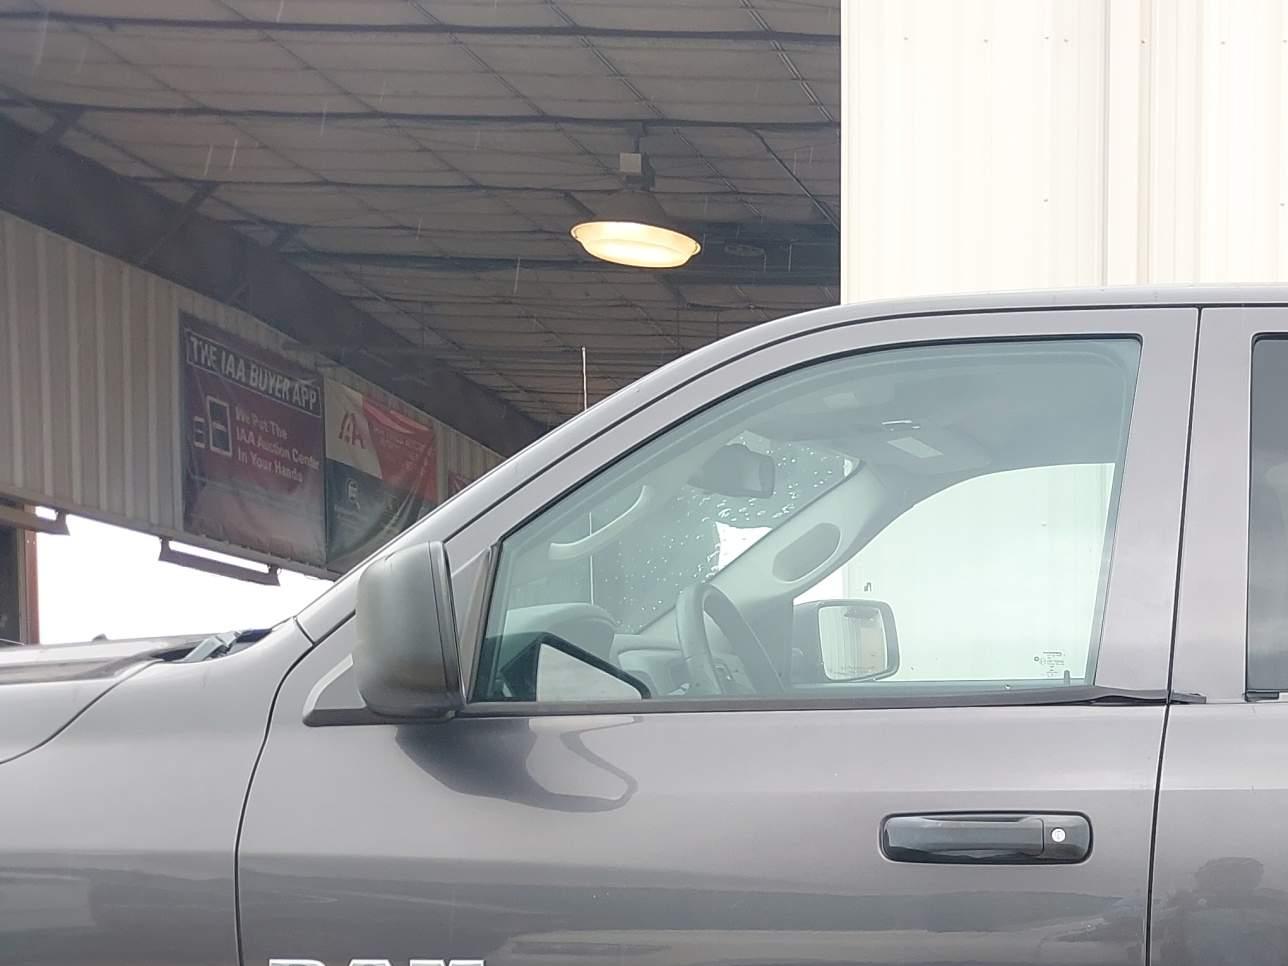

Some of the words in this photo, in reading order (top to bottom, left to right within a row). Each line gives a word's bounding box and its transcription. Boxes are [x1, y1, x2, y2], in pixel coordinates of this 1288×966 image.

[190, 336, 217, 371] THE
[221, 350, 246, 383] IAA
[249, 362, 290, 401] BUYER
[292, 383, 317, 410] APP
[236, 426, 256, 446] IAA
[257, 435, 290, 461] Auction
[270, 421, 288, 440] The
[238, 448, 248, 465] In
[249, 451, 272, 473] Your
[273, 460, 303, 482] Hands
